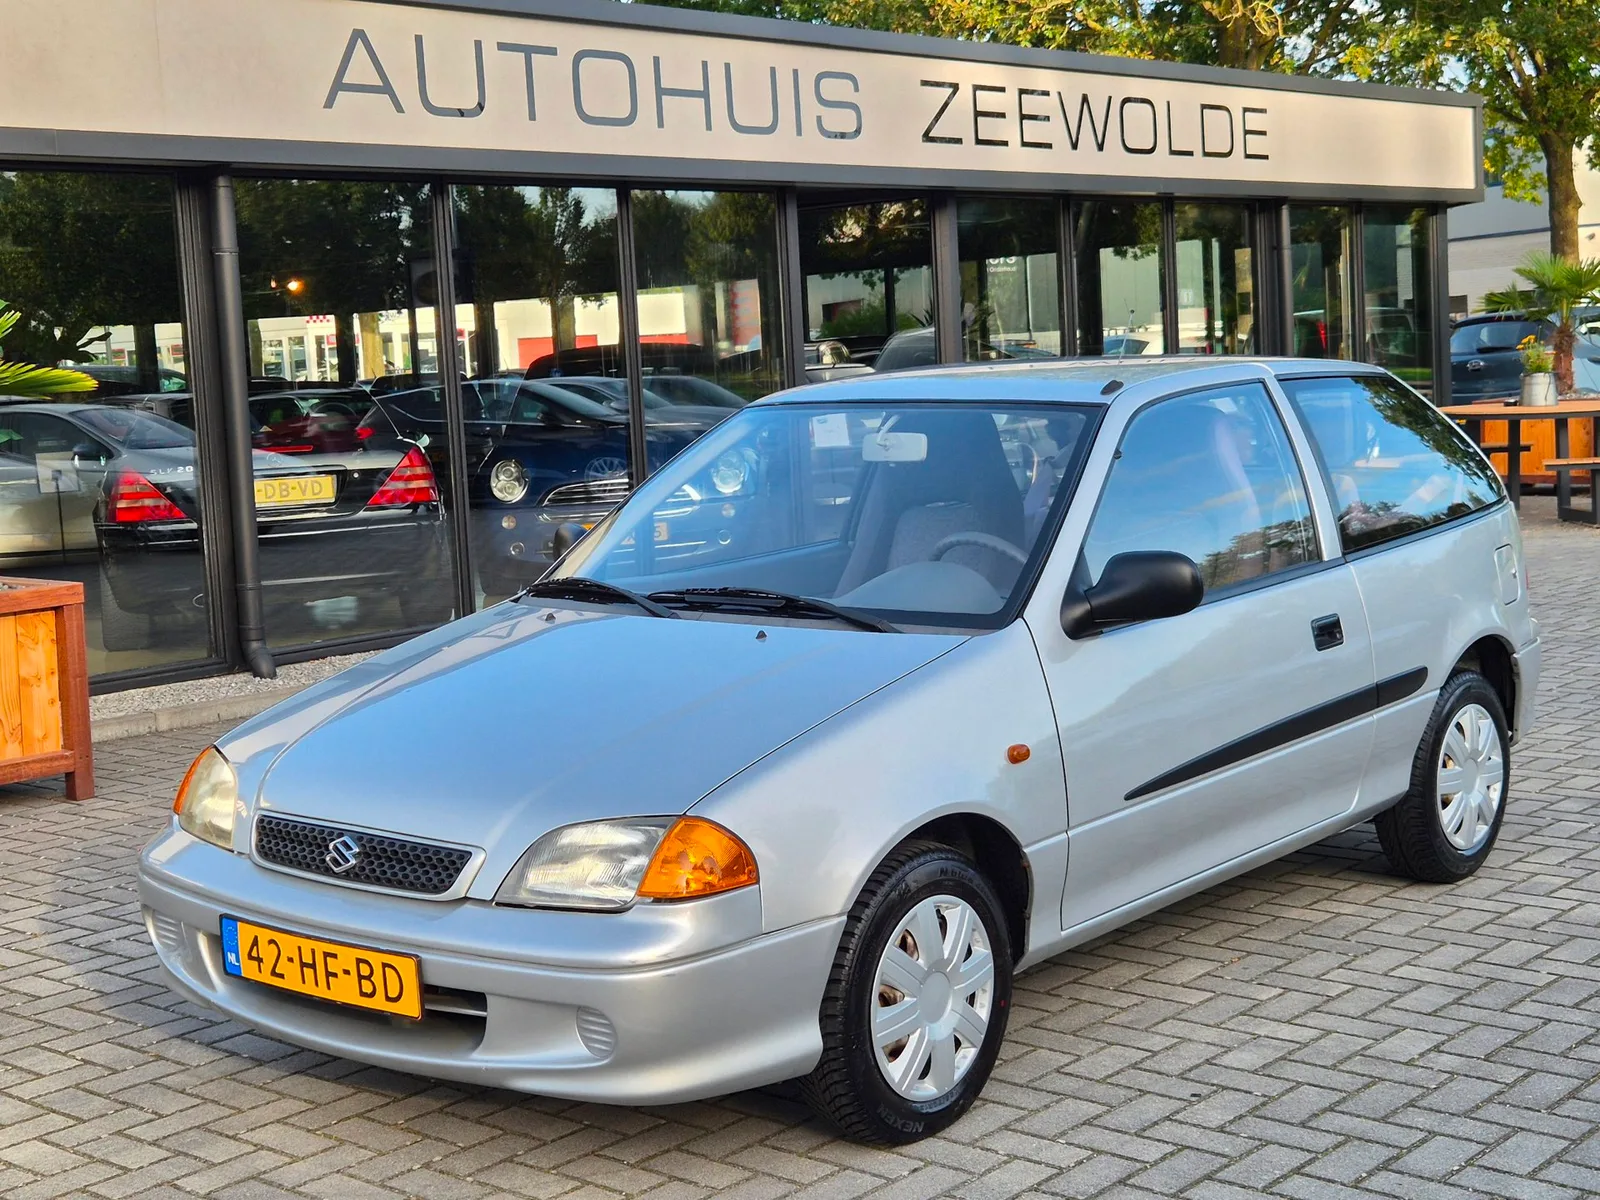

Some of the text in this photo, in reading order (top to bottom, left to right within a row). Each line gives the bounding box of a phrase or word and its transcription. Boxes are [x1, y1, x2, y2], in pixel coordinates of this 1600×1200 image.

[323, 28, 1269, 160] AUTOHUIS ZEEWOLDE
[227, 951, 240, 966] NL
[247, 934, 404, 1003] 42-HF-BD
[876, 1102, 925, 1133] NEXEN
